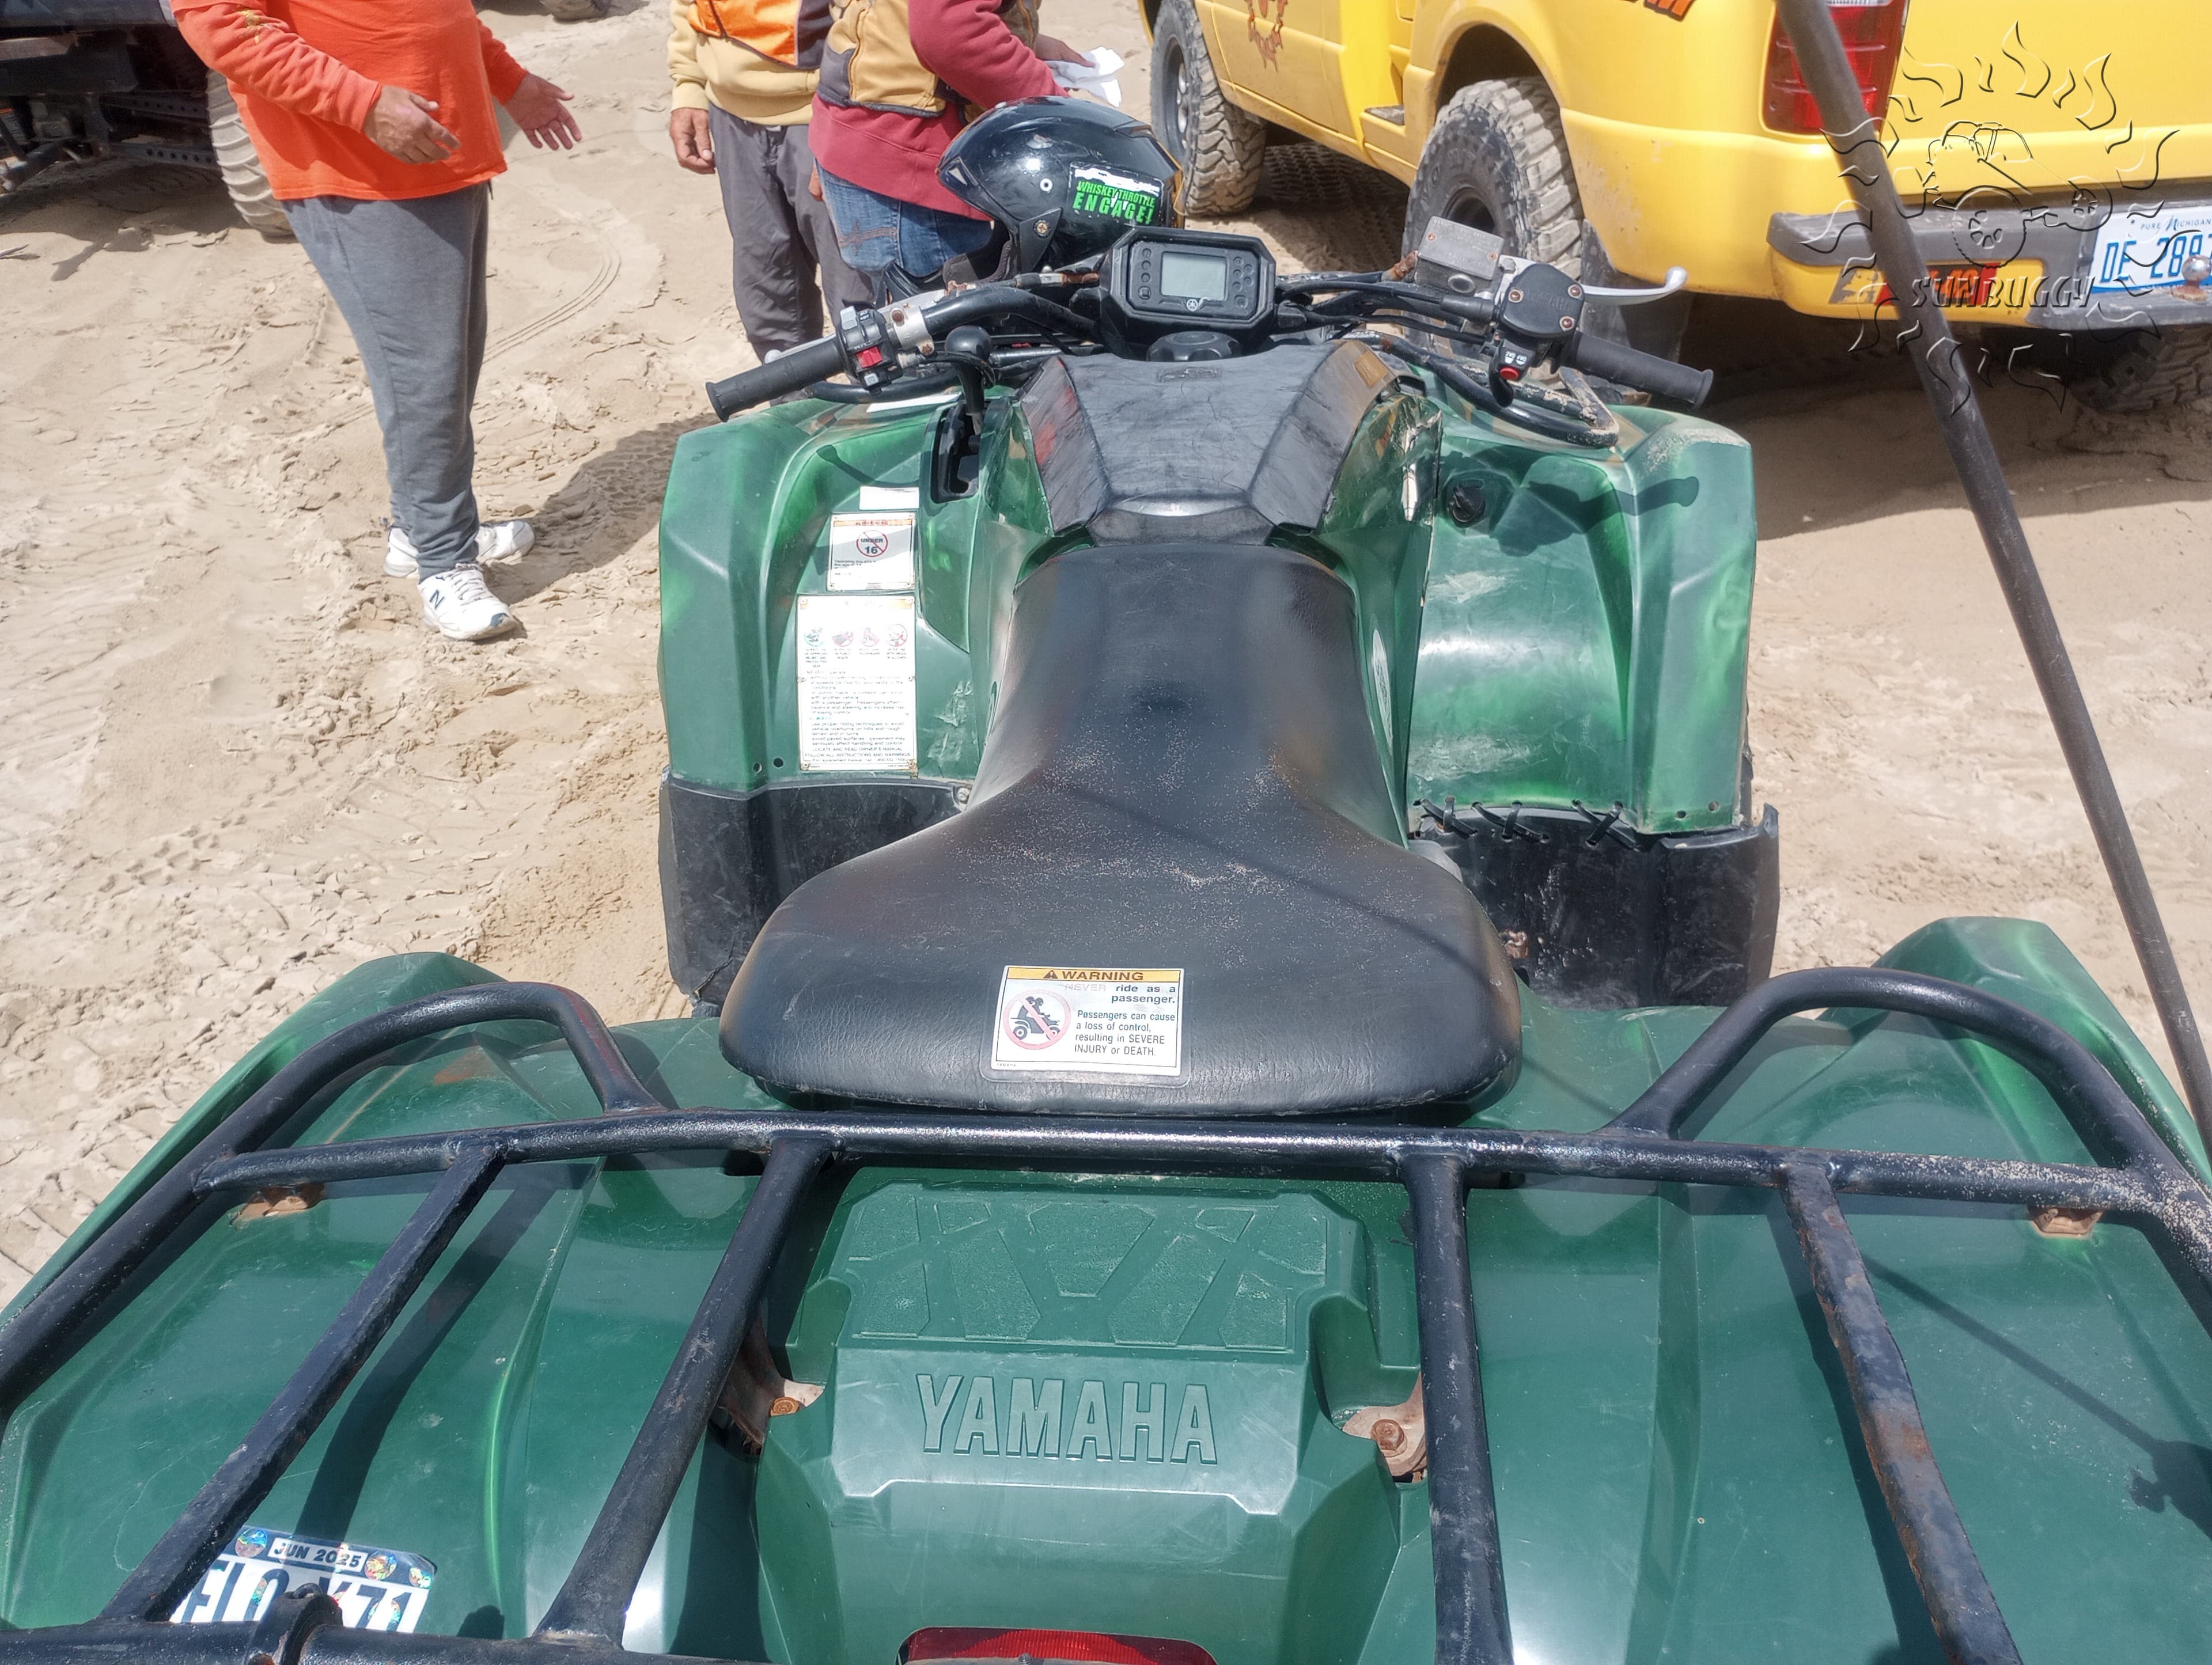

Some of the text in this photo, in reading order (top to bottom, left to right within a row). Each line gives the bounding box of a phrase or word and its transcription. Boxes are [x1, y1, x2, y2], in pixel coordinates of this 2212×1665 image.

[1077, 180, 1156, 208] WHISKEY THROTTLE
[1073, 192, 1155, 225] ENGAGE!
[2140, 215, 2211, 232] PURE MICHIGAN
[2100, 240, 2137, 283] DE
[865, 546, 878, 554] 16
[429, 589, 445, 609] N
[1062, 970, 1144, 981] WARNING
[1065, 983, 1107, 992] NEVER
[1111, 995, 1175, 1004] passenger.
[1077, 1010, 1127, 1021] Passengers
[1085, 1022, 1103, 1030] loss
[1107, 1022, 1116, 1030] of
[1119, 1023, 1151, 1033] control,
[1075, 1033, 1165, 1044] resulting in SEVERE
[1074, 1044, 1107, 1053] INJURY
[916, 1374, 1217, 1465] YAMAHA
[274, 1542, 362, 1568] JUN 2025
